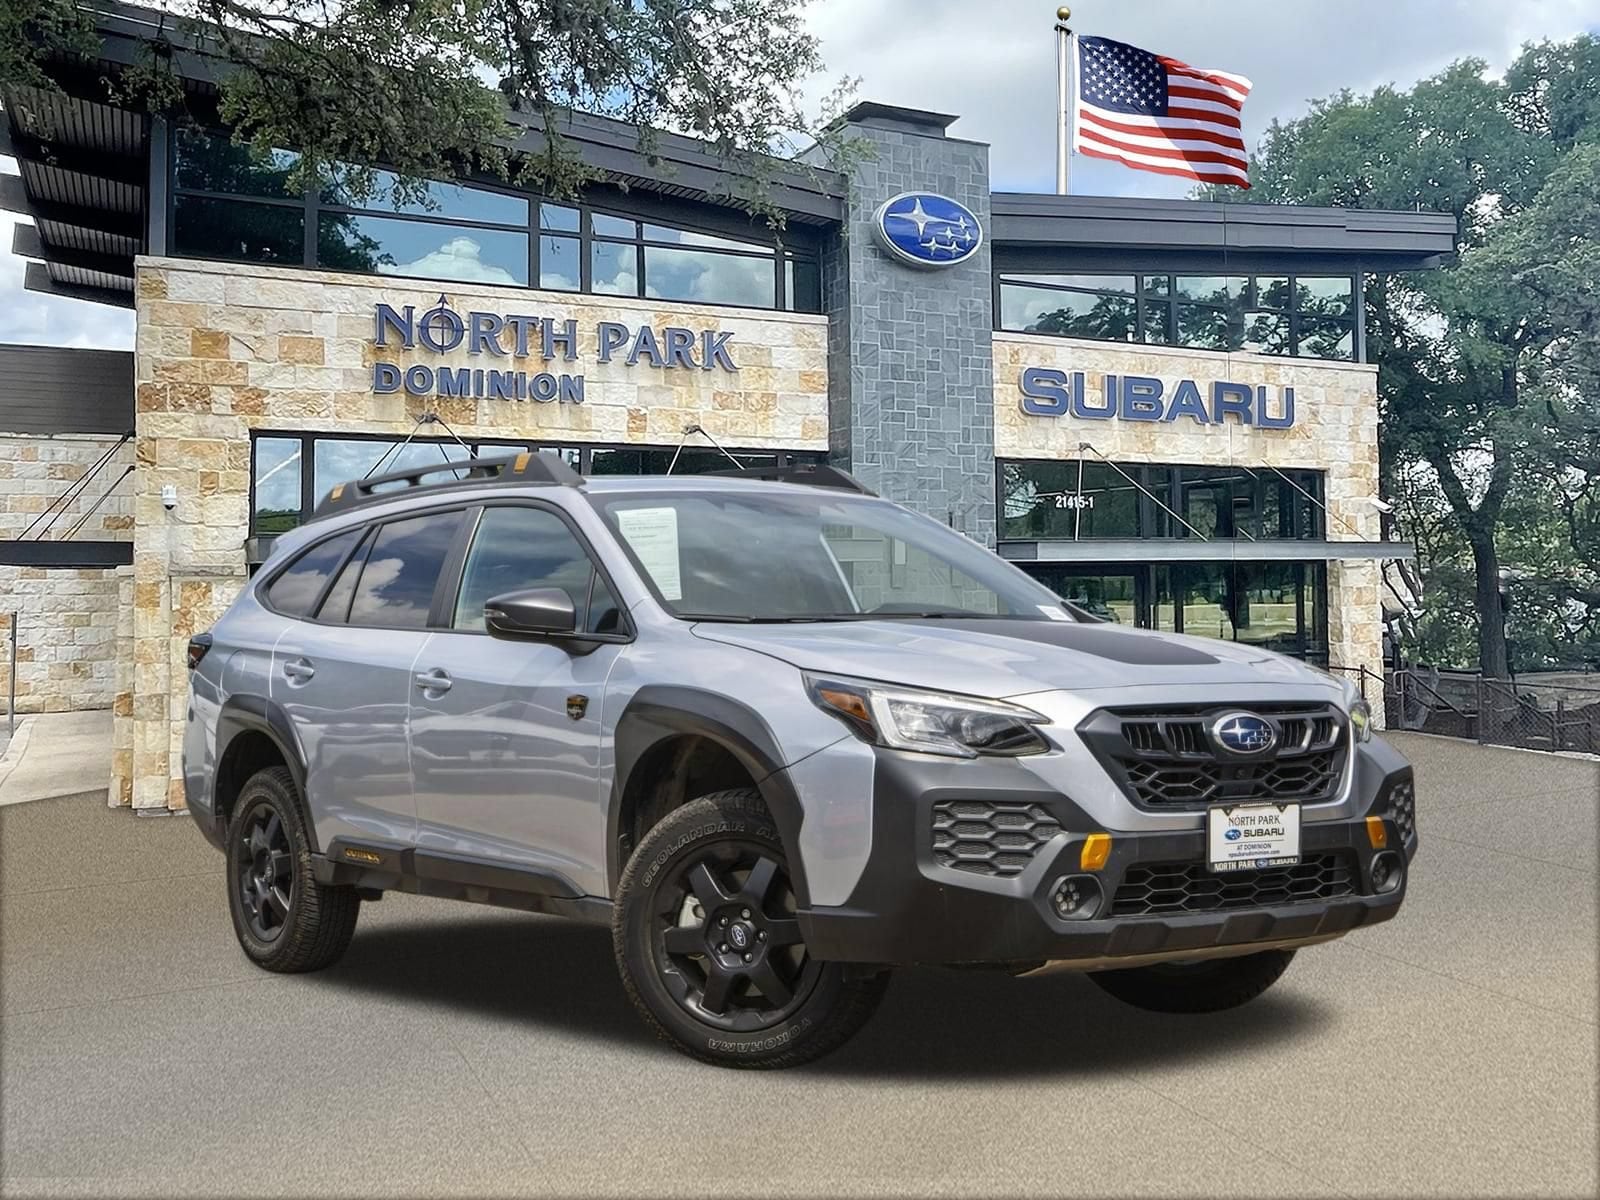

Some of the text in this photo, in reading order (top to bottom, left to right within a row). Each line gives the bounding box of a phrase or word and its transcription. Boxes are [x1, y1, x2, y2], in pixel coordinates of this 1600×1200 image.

[375, 295, 742, 372] NORTH PARK
[373, 362, 585, 403] DOMINION
[1020, 367, 1295, 430] SUBARU
[1228, 814, 1281, 826] NORTH PARK
[1243, 827, 1285, 838] SUBARU
[642, 821, 745, 888] GEOLANDAR
[1244, 842, 1272, 850] DOMINION
[1214, 857, 1298, 873] NORTH PARK SUBARU
[708, 1017, 812, 1053] YOKOHAMA
